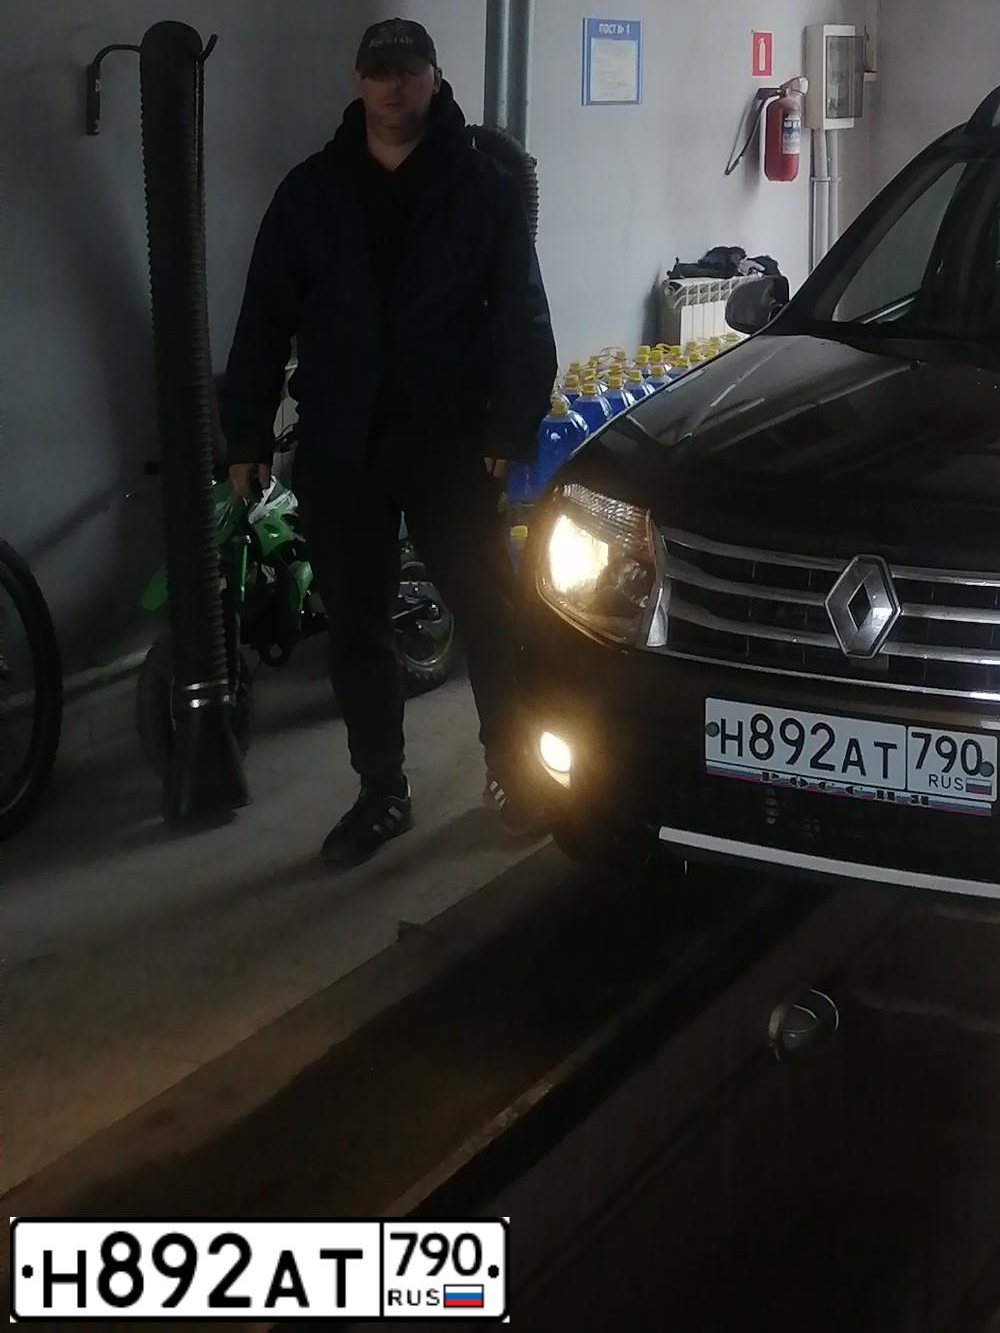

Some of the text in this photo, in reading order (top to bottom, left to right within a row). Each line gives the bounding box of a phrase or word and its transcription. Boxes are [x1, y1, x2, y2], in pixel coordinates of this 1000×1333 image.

[719, 713, 983, 780] Н892АТ 790
[928, 773, 964, 791] RUS
